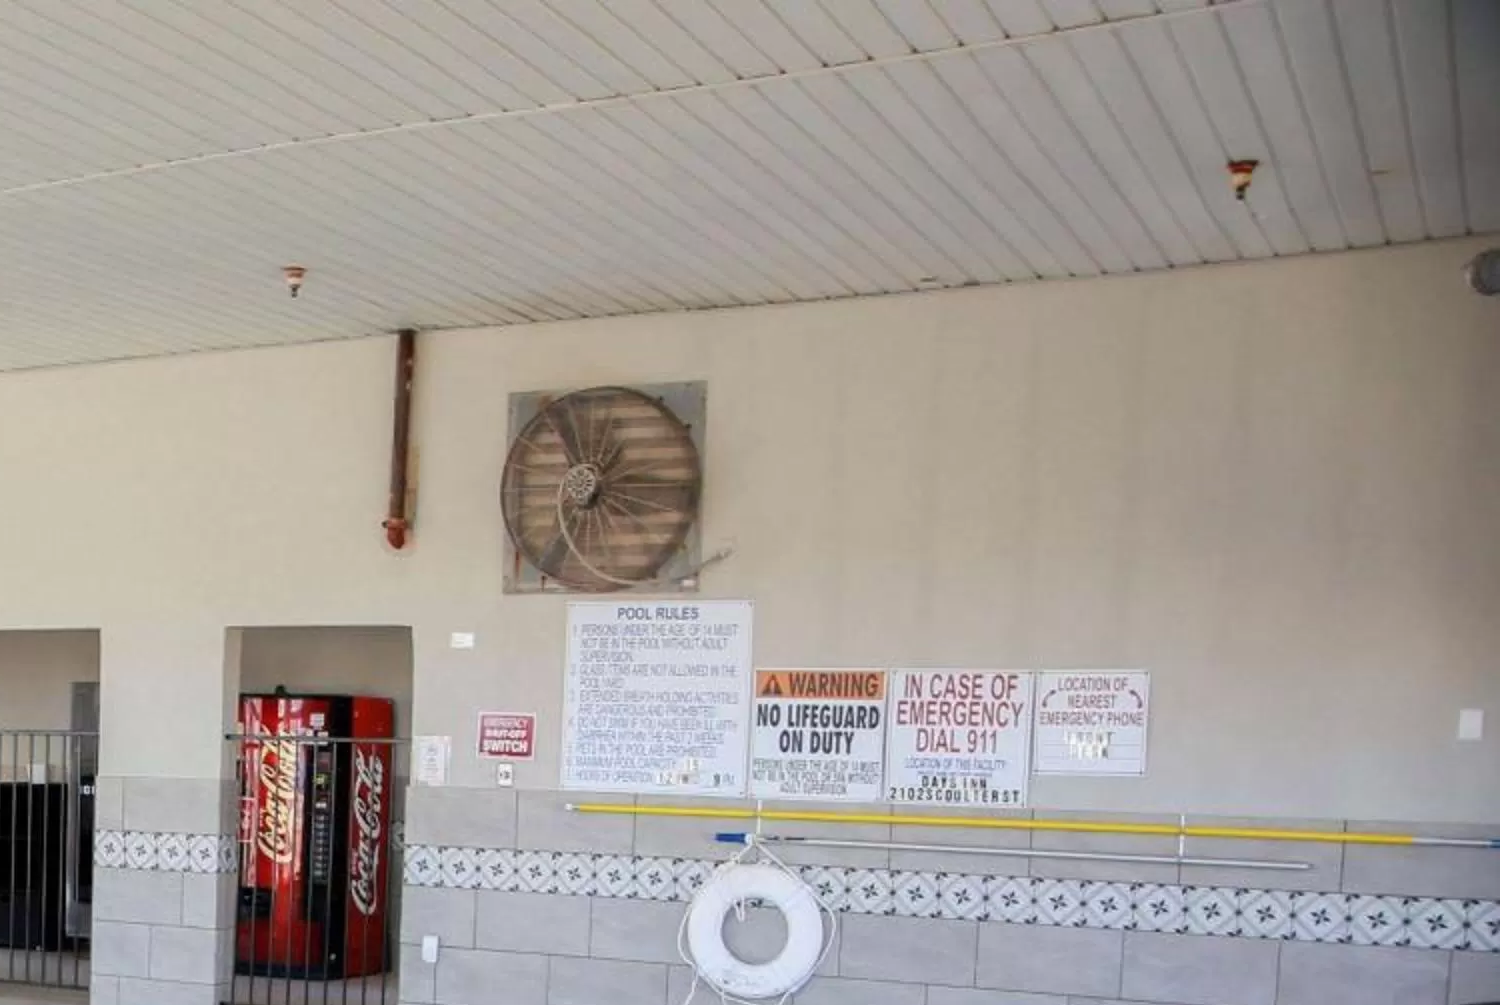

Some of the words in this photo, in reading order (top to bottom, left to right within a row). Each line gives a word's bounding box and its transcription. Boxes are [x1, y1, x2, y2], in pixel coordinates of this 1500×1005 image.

[617, 607, 652, 620] POOL
[656, 607, 700, 620] RULES
[789, 671, 879, 697] WARNING
[904, 674, 922, 698] IN
[930, 674, 984, 699] CASE
[991, 675, 1019, 700] OF
[1058, 677, 1111, 691] LOCATION
[1113, 677, 1129, 691] OF
[896, 701, 1024, 728] EMERGENCY
[1067, 694, 1118, 709] NEAREST
[757, 703, 781, 727] NO
[787, 704, 880, 729] LIFEGUARD
[1040, 711, 1104, 726] EMERGENCY
[1107, 711, 1145, 727] PHONE
[483, 739, 529, 753] SWITCH
[779, 729, 803, 753] ON
[810, 730, 854, 755] DUTY
[916, 728, 961, 753] DIAL
[967, 729, 998, 754] 911
[351, 743, 384, 915] Coca-Cola
